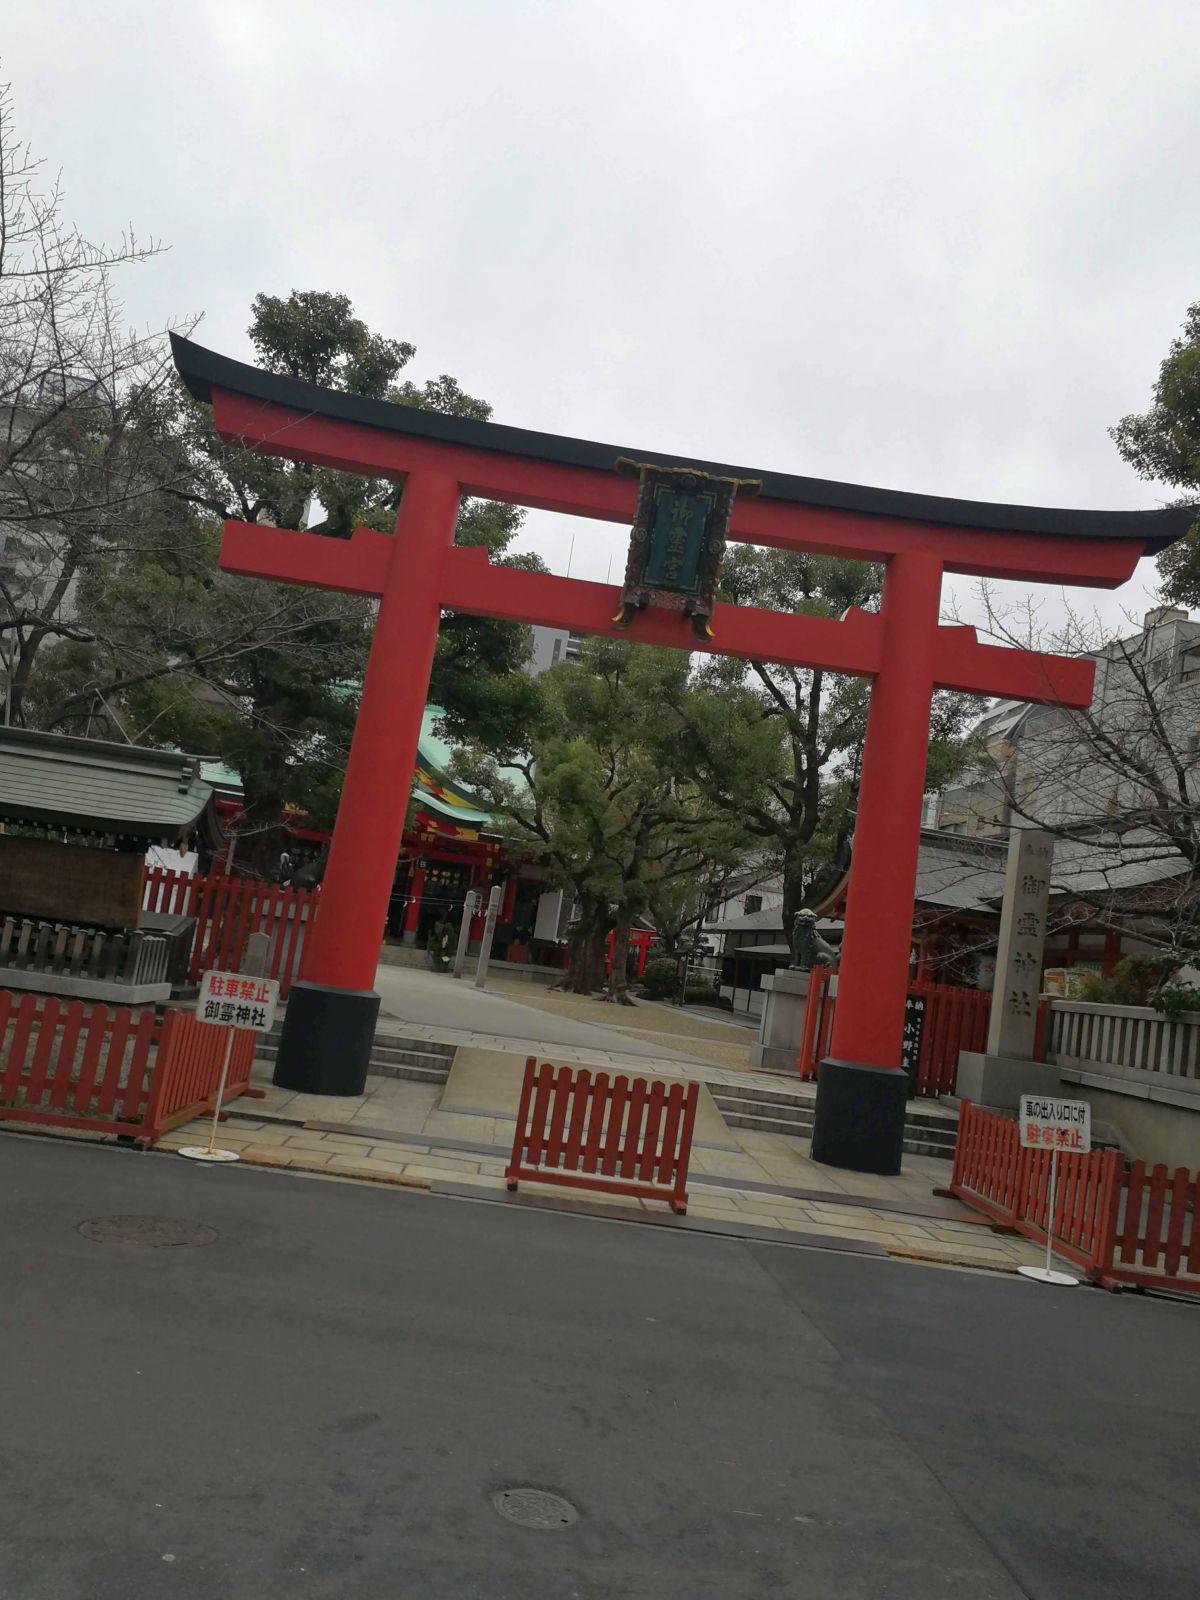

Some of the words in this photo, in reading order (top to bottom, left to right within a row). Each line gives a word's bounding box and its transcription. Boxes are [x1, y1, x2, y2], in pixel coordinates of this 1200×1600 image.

[208, 975, 269, 1003] 駐車禁止
[204, 1000, 266, 1026] 御霊神社
[1025, 1101, 1085, 1124] 車の出入り口に付
